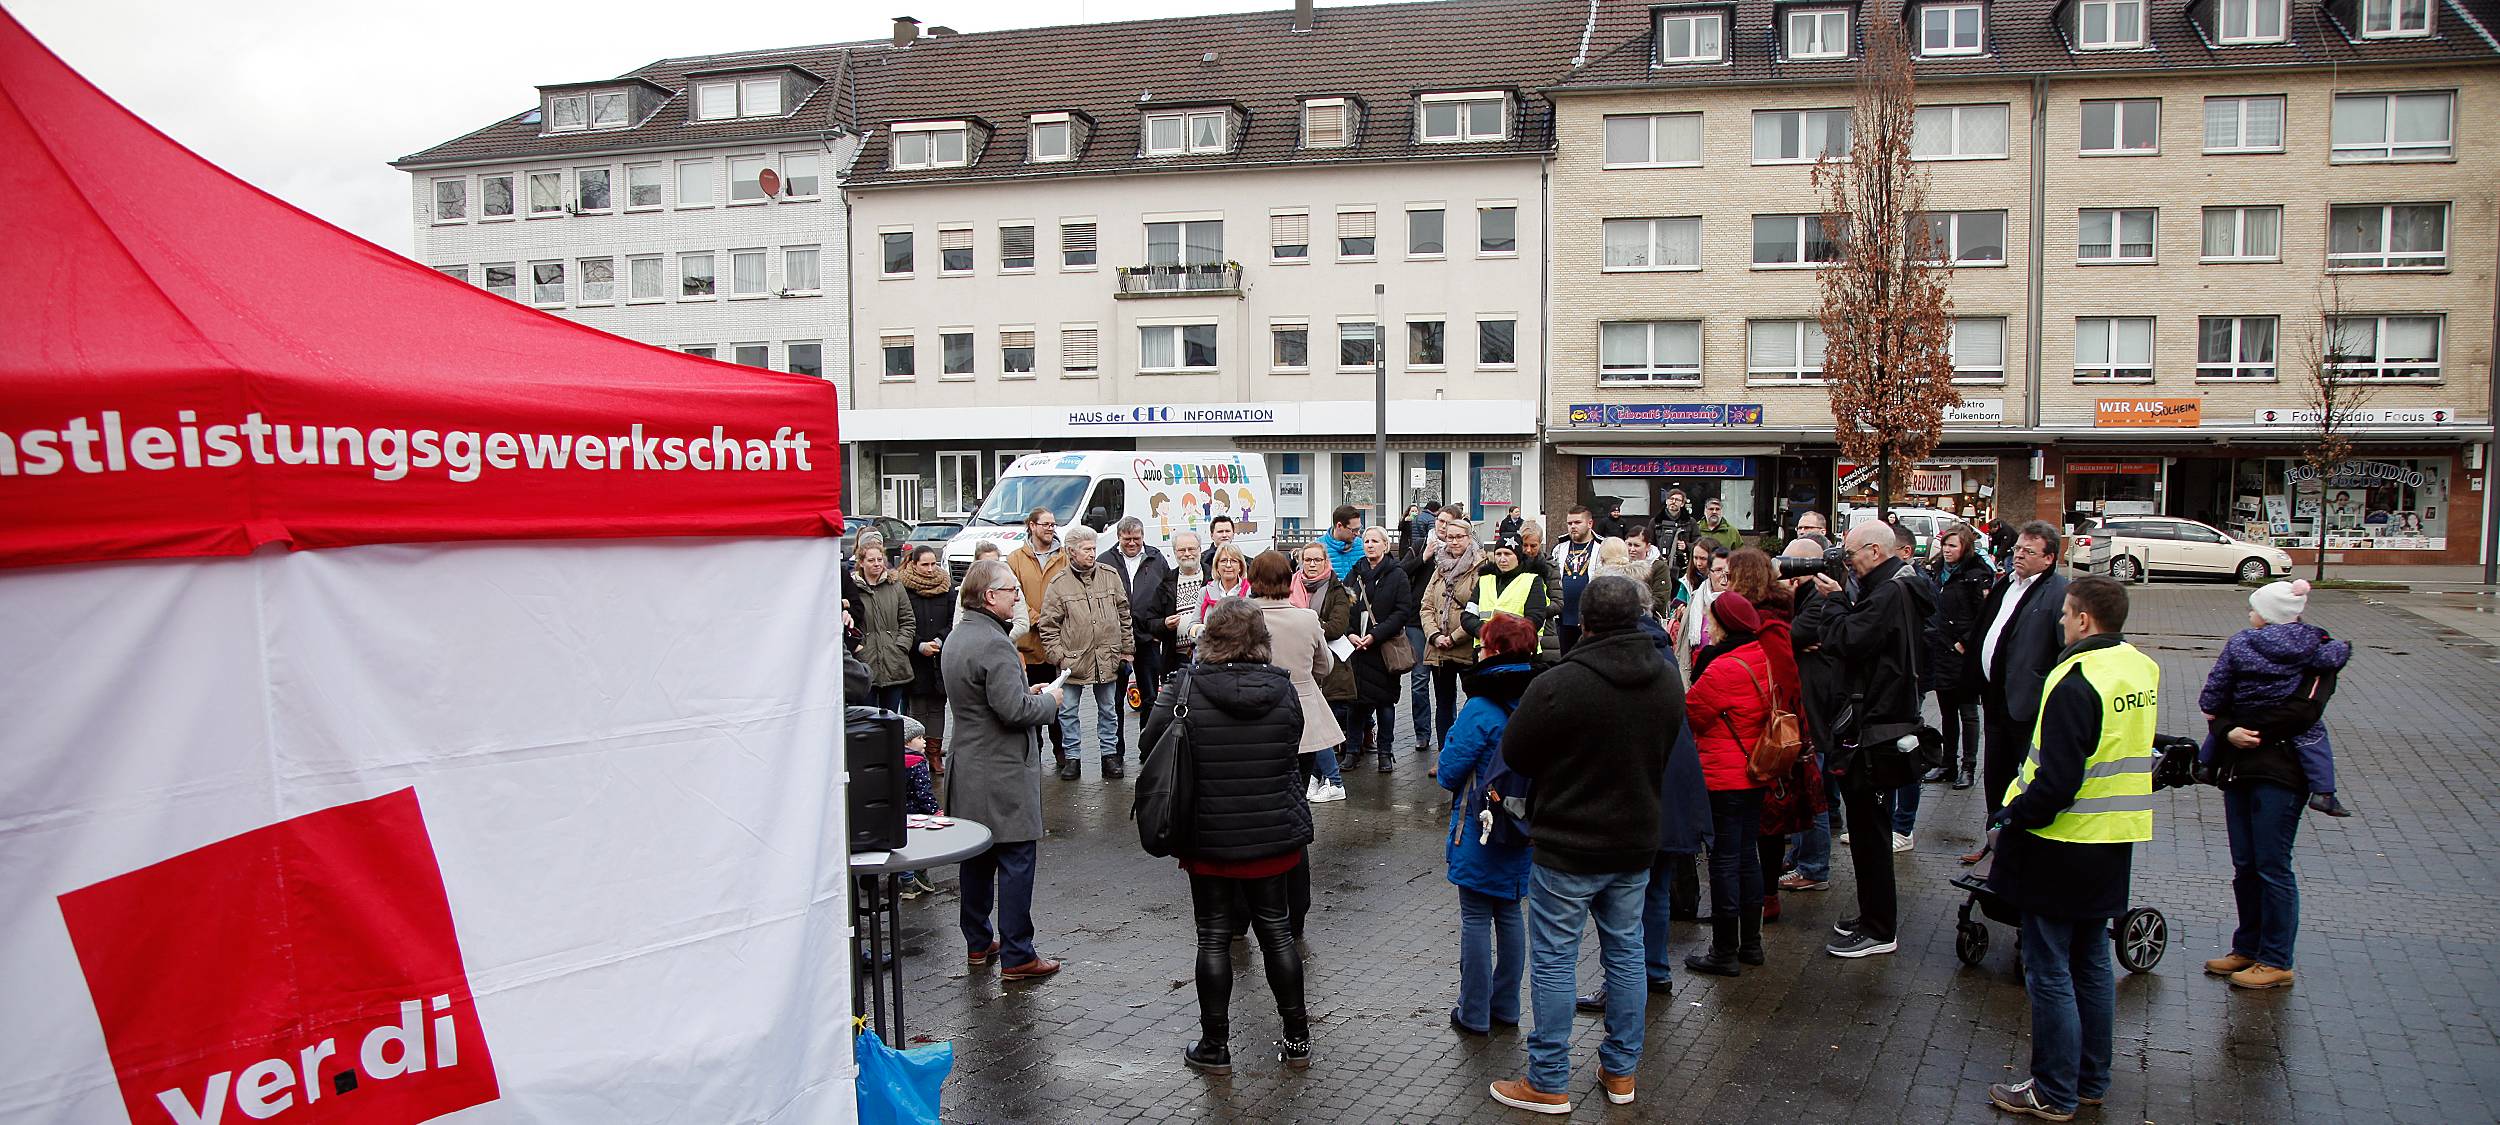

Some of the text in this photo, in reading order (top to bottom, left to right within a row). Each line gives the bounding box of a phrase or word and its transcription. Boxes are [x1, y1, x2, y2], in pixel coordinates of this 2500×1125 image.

[1069, 406, 1274, 422] HAUS der GEO INFORMATION
[1617, 408, 1719, 420] Eiscafé Sanremo
[2099, 402, 2164, 413] WIR AUS
[1949, 412, 2000, 420] Folkenborn
[2292, 411, 2321, 422] Foto
[2384, 411, 2425, 422] Focus
[1163, 463, 1250, 485] SPIELMOBIL
[1610, 461, 1728, 474] Eiscafé Sanremo
[2284, 459, 2424, 488] FOSTUDIO
[1913, 474, 1952, 492] REDUZIERT
[156, 993, 458, 1125] ver.di
